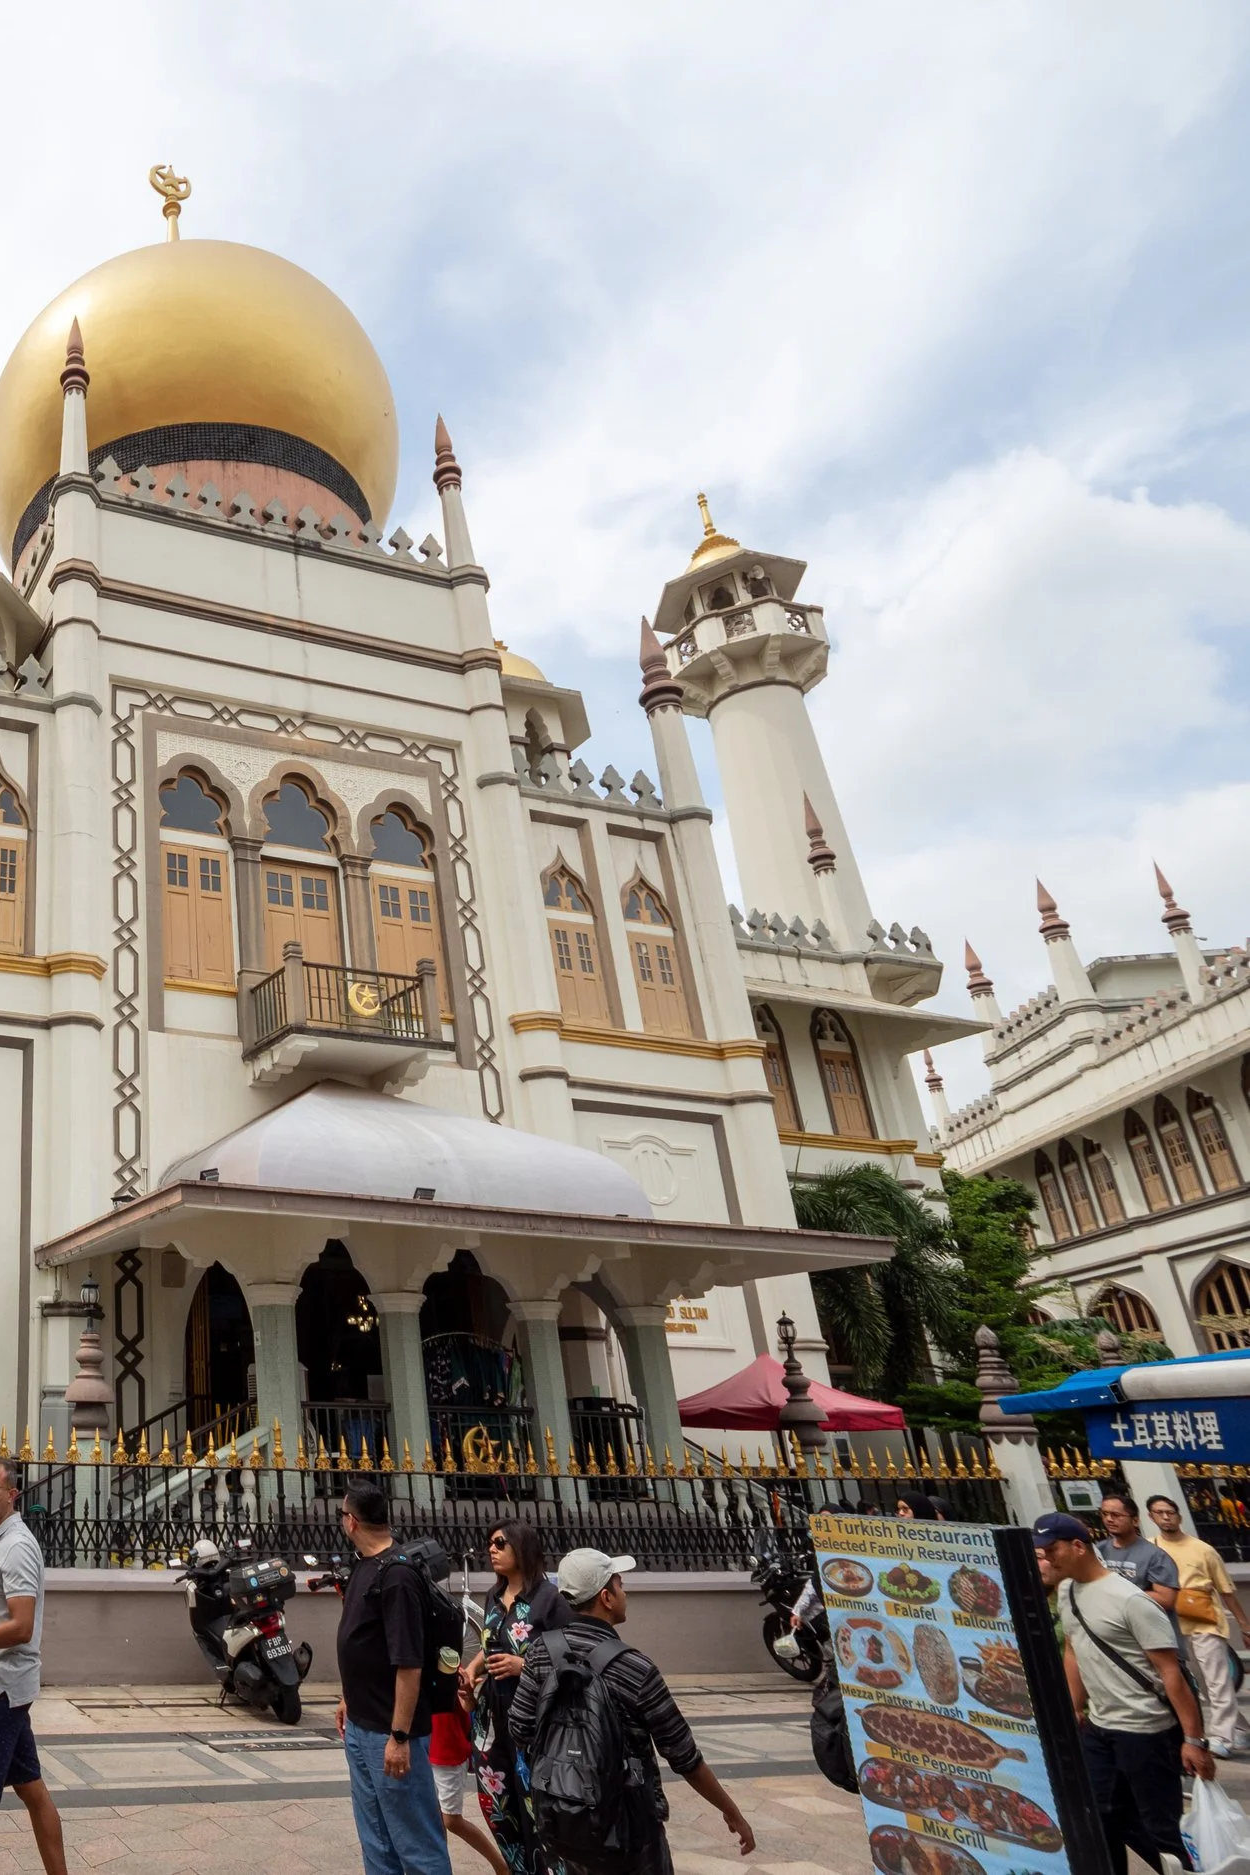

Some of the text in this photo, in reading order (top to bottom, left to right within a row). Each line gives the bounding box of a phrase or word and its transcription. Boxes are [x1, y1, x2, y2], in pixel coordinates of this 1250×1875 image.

[679, 1306, 709, 1320] SULTAN
[1110, 1410, 1224, 1450] 土耳其料理
[815, 1518, 993, 1548] #1 Turkish Restaurant
[814, 1536, 999, 1566] Selected Family Restaurant
[825, 1594, 879, 1613] Hummus
[893, 1604, 937, 1621] Falafel
[953, 1612, 1015, 1633] Halloumi
[266, 1644, 292, 1659] 6939U
[267, 1636, 282, 1648] FBP
[841, 1684, 874, 1700] Mezza
[876, 1691, 913, 1709] Platter
[968, 1710, 1040, 1736] Shawarma
[891, 1748, 993, 1783] Pide Pepperoni
[922, 1819, 989, 1852] Mix Grill
